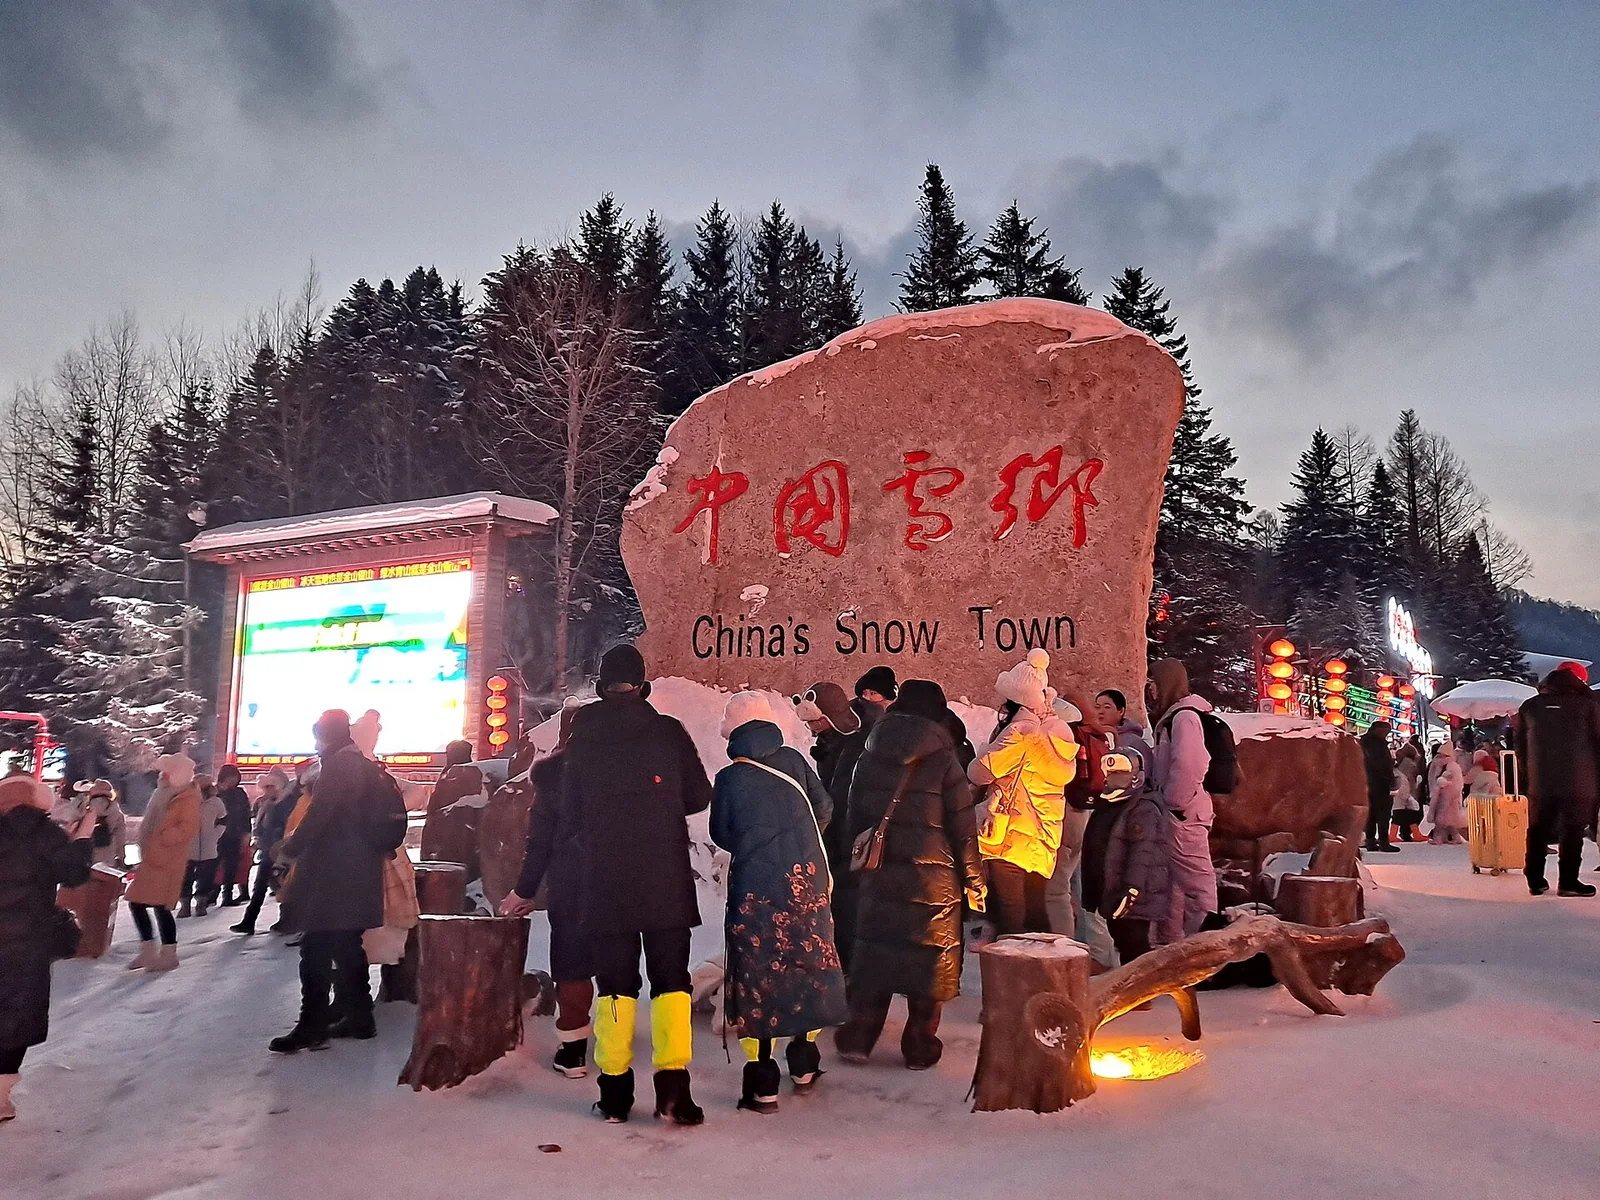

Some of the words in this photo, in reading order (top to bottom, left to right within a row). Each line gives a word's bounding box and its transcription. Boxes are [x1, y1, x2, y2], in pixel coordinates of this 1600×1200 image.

[693, 613, 808, 659] China's
[836, 608, 939, 655] Snow
[969, 606, 1076, 652] Town
